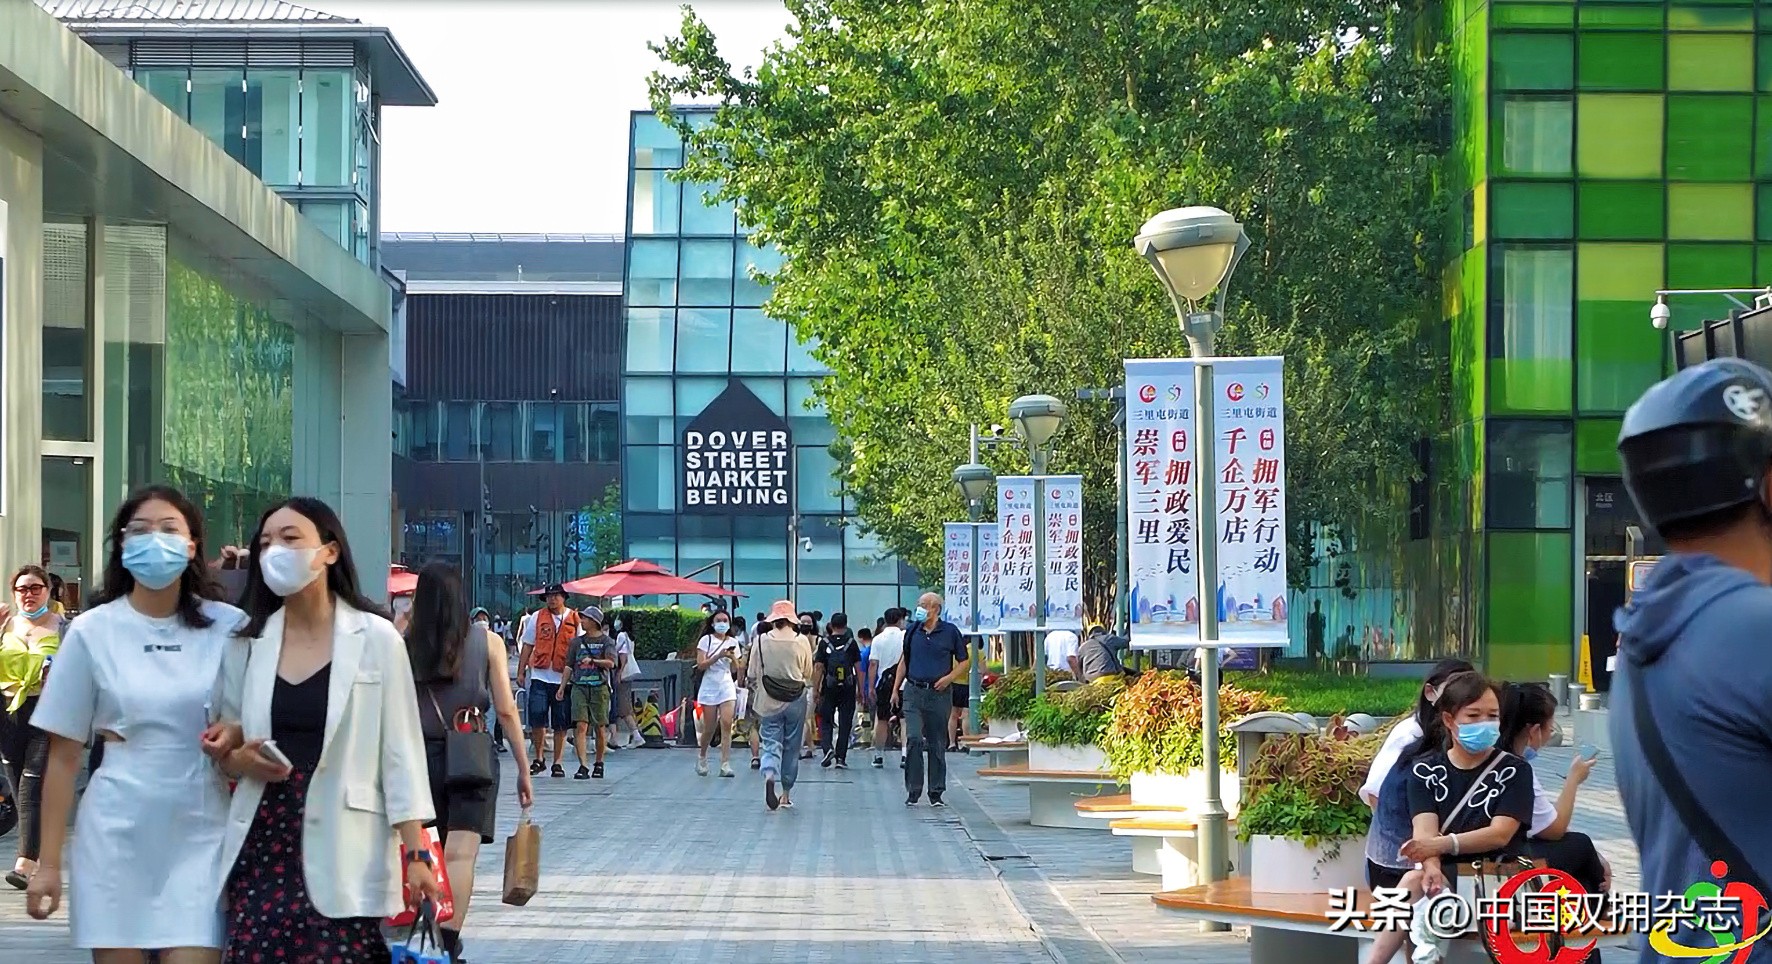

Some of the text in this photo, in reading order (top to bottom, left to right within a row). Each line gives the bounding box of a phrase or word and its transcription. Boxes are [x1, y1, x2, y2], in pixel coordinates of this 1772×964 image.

[687, 431, 787, 449] DOVER
[1132, 408, 1190, 420] 三里屯街道
[1220, 407, 1277, 419] 三里屯街道
[686, 451, 787, 468] STREET
[687, 471, 787, 487] MARKET
[1132, 428, 1160, 545] 崇军三里
[1220, 427, 1250, 544] 千企万店
[687, 489, 788, 504] BEIJING
[1164, 460, 1192, 574] 拥政爱民
[1252, 458, 1280, 573] 拥军行动
[1002, 514, 1016, 576] 千企万店
[1018, 530, 1033, 592] 拥军行动
[1048, 513, 1062, 575] 崇军三里
[1064, 530, 1079, 592] 拥政爱民
